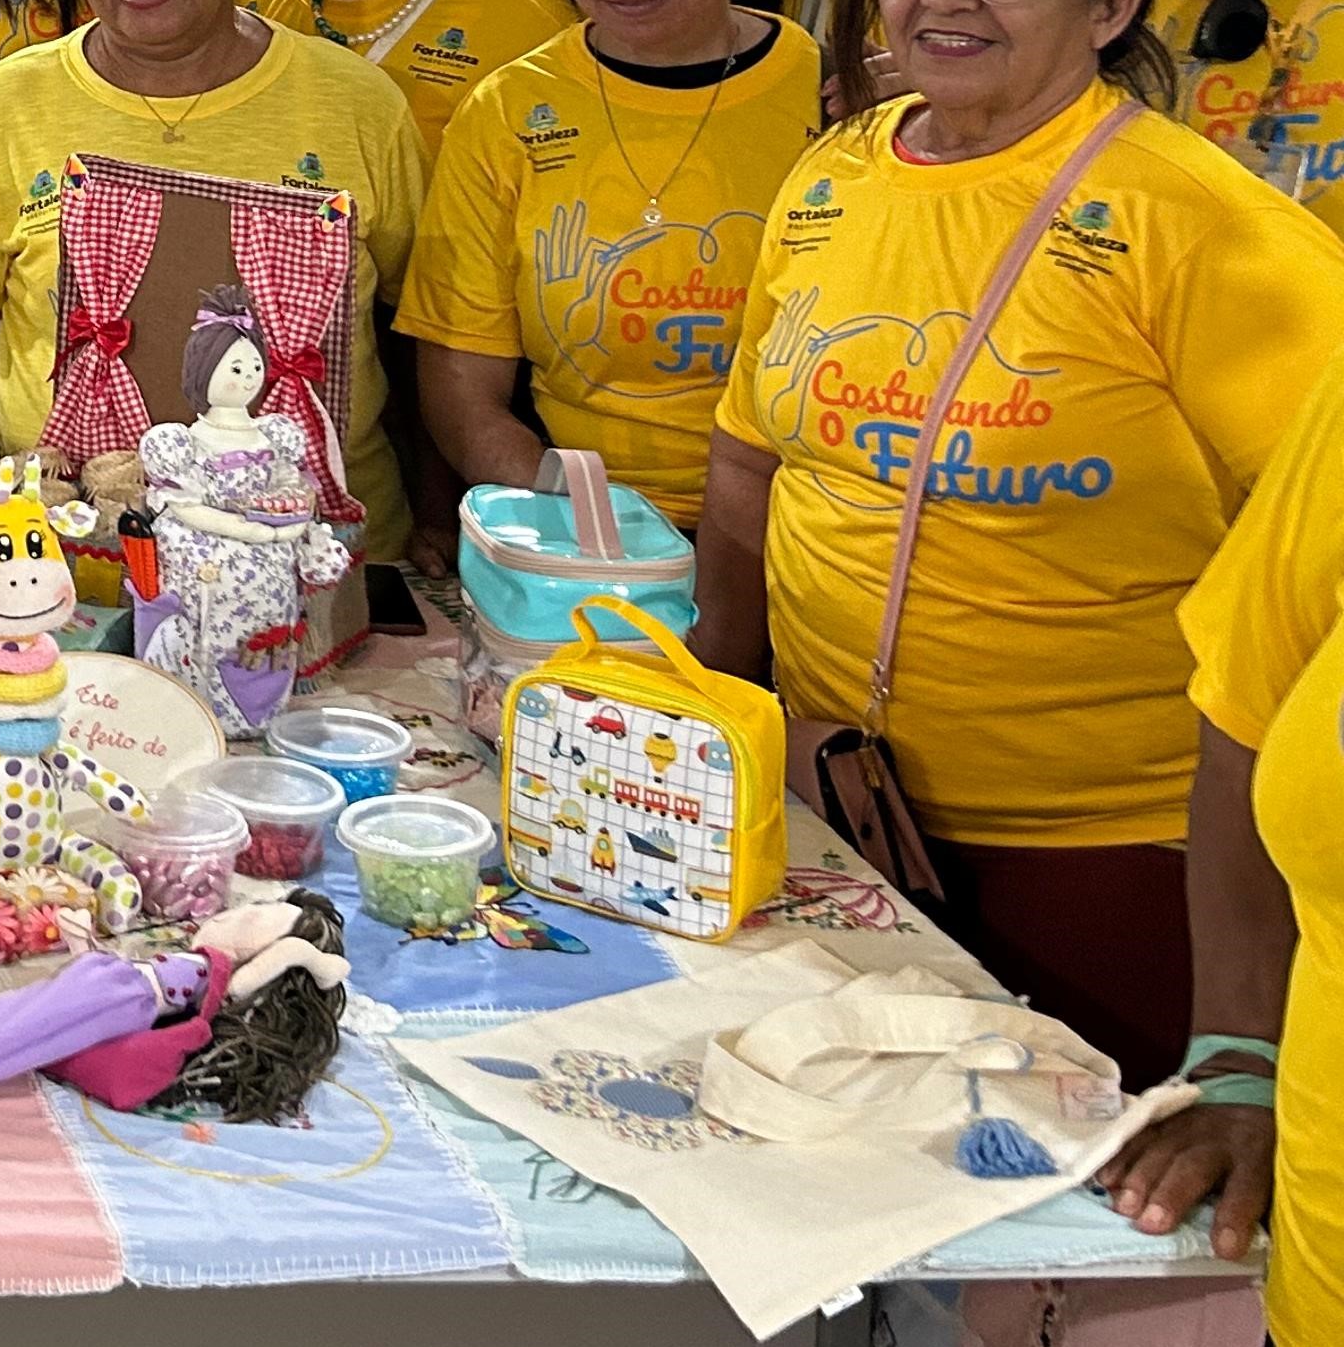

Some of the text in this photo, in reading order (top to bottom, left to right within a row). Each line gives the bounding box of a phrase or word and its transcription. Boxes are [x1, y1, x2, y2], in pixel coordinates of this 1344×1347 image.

[412, 43, 480, 66] Fortaleza
[19, 194, 62, 217] Fortale
[787, 207, 844, 221] ortaleza
[610, 267, 749, 311] Costur
[811, 359, 1054, 428] Costuando
[75, 682, 120, 710] Este
[68, 719, 168, 757] é feito de
